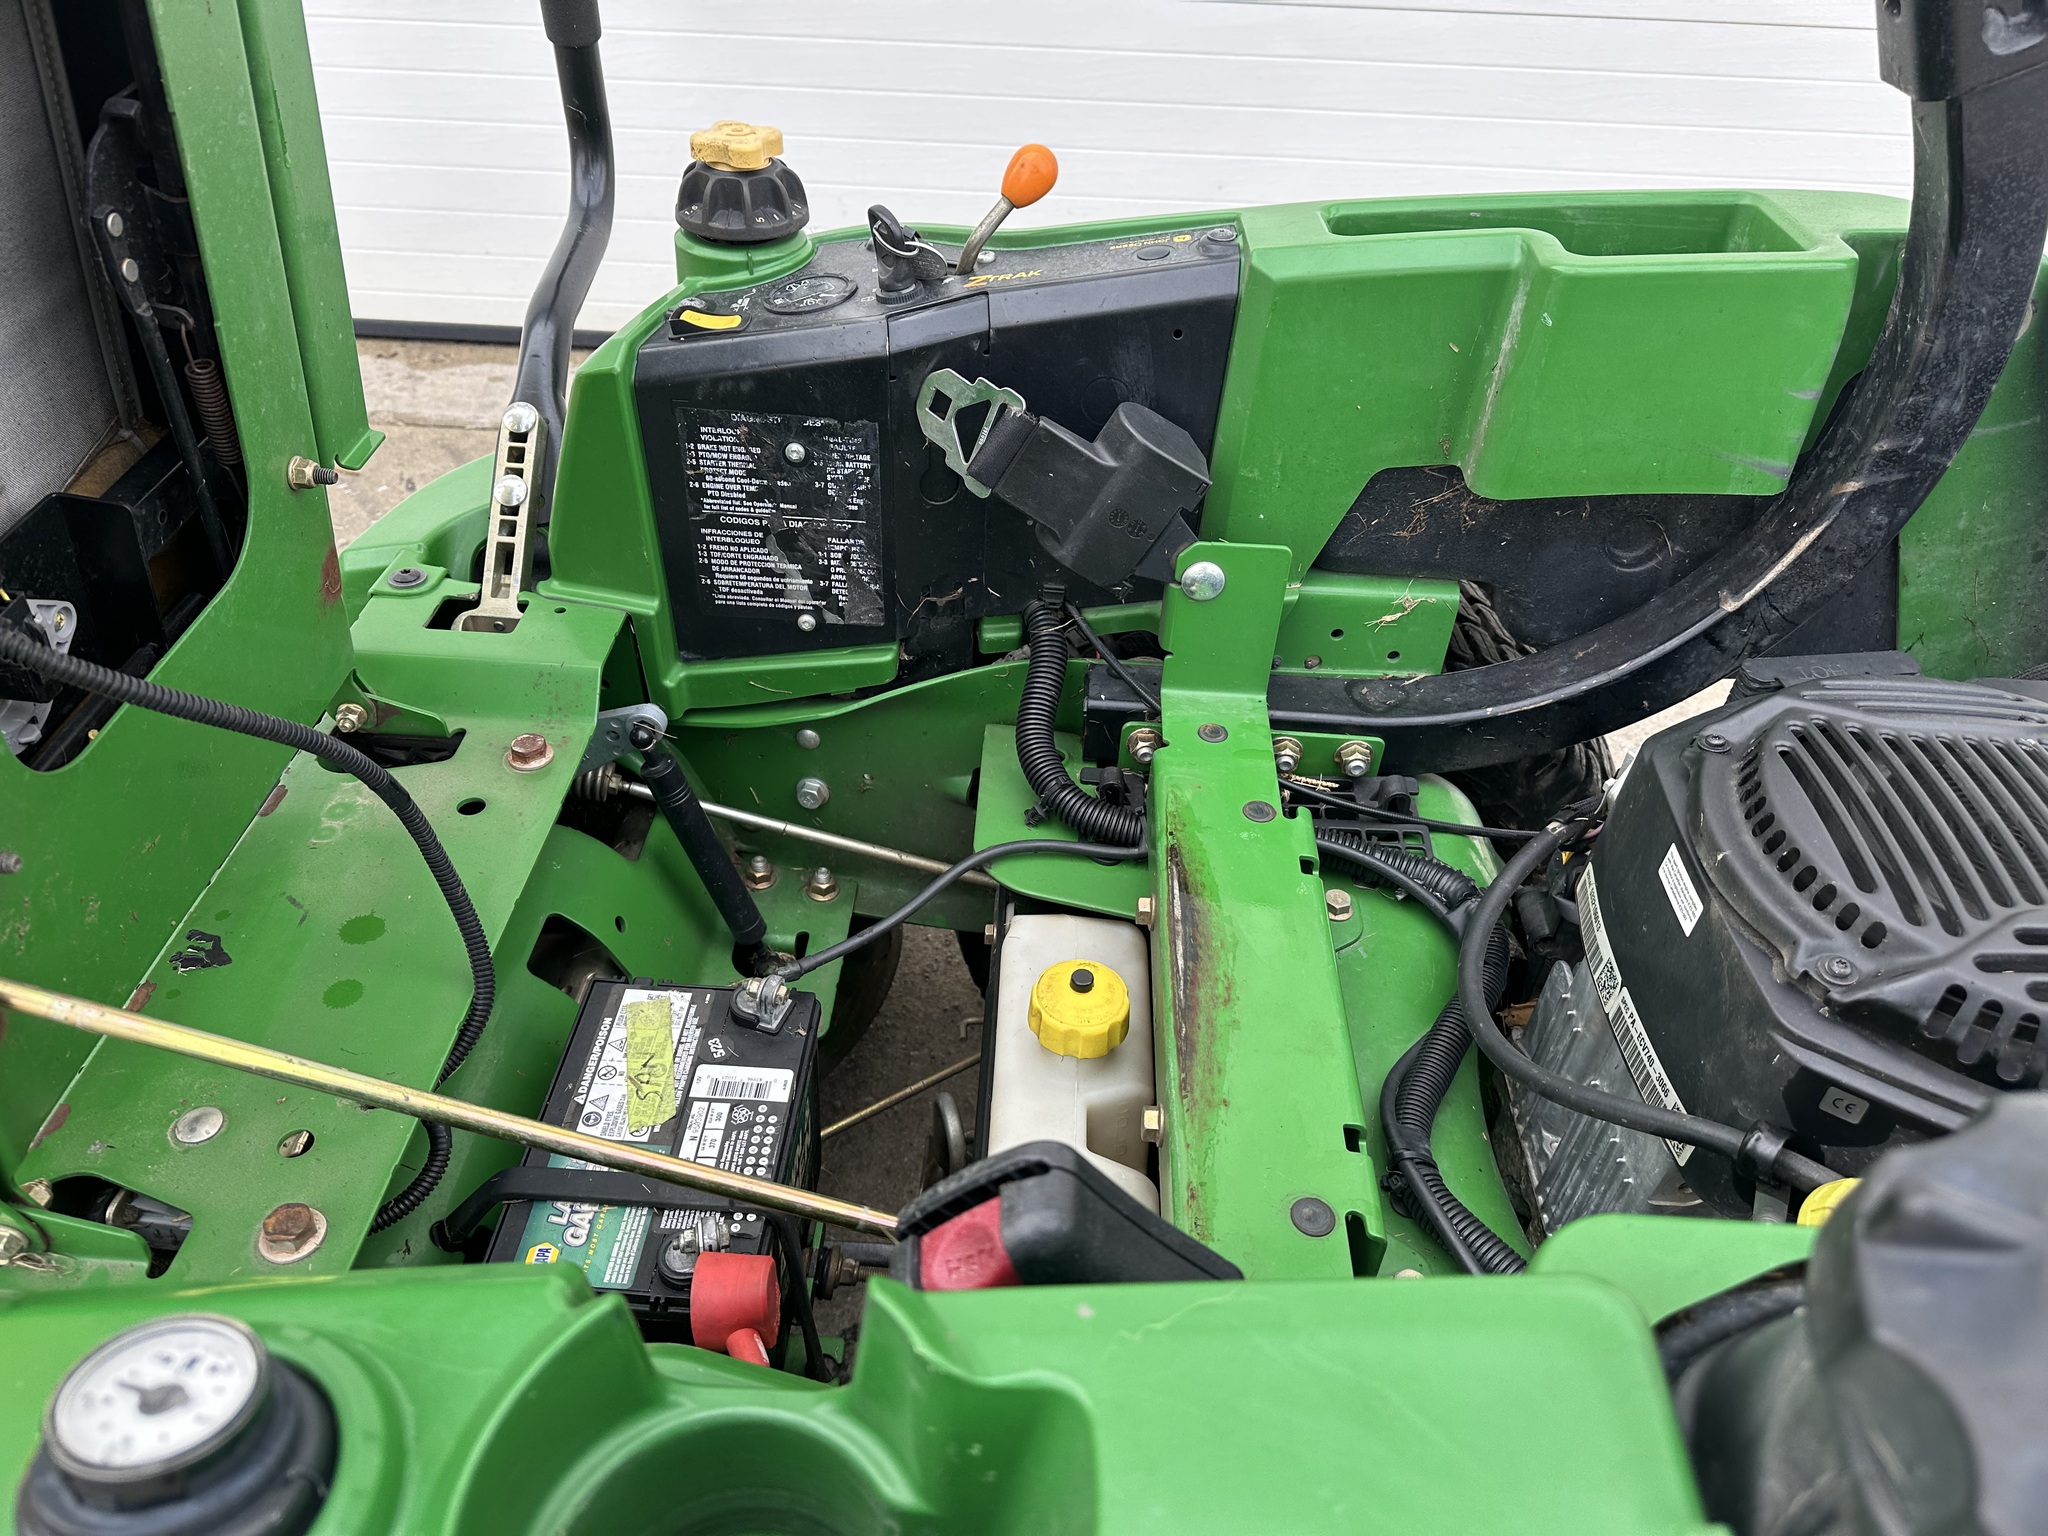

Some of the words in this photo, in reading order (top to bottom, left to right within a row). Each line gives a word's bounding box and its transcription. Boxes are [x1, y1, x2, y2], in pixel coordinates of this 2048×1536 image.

[845, 461, 871, 470] BATTERY
[719, 515, 761, 526] CODIGOS
[700, 527, 753, 537] INFRACCIONES
[705, 535, 761, 545] INTERBLOQUEO
[709, 544, 729, 552] FRENO
[709, 551, 742, 560] TDF/CORTE
[742, 554, 779, 562] ENGRANADO
[710, 558, 729, 566] MODO
[738, 560, 776, 569] PROTECCION
[776, 562, 803, 571] TERMICA
[720, 566, 761, 575] ARRANCADOR
[730, 587, 764, 595] desactivada
[1620, 995, 1630, 1014] SPEC
[708, 1037, 725, 1058] 5/23
[577, 1017, 613, 1101] DANGER/POISON
[1832, 1097, 1857, 1115] CE
[588, 1233, 599, 1256] MOST
